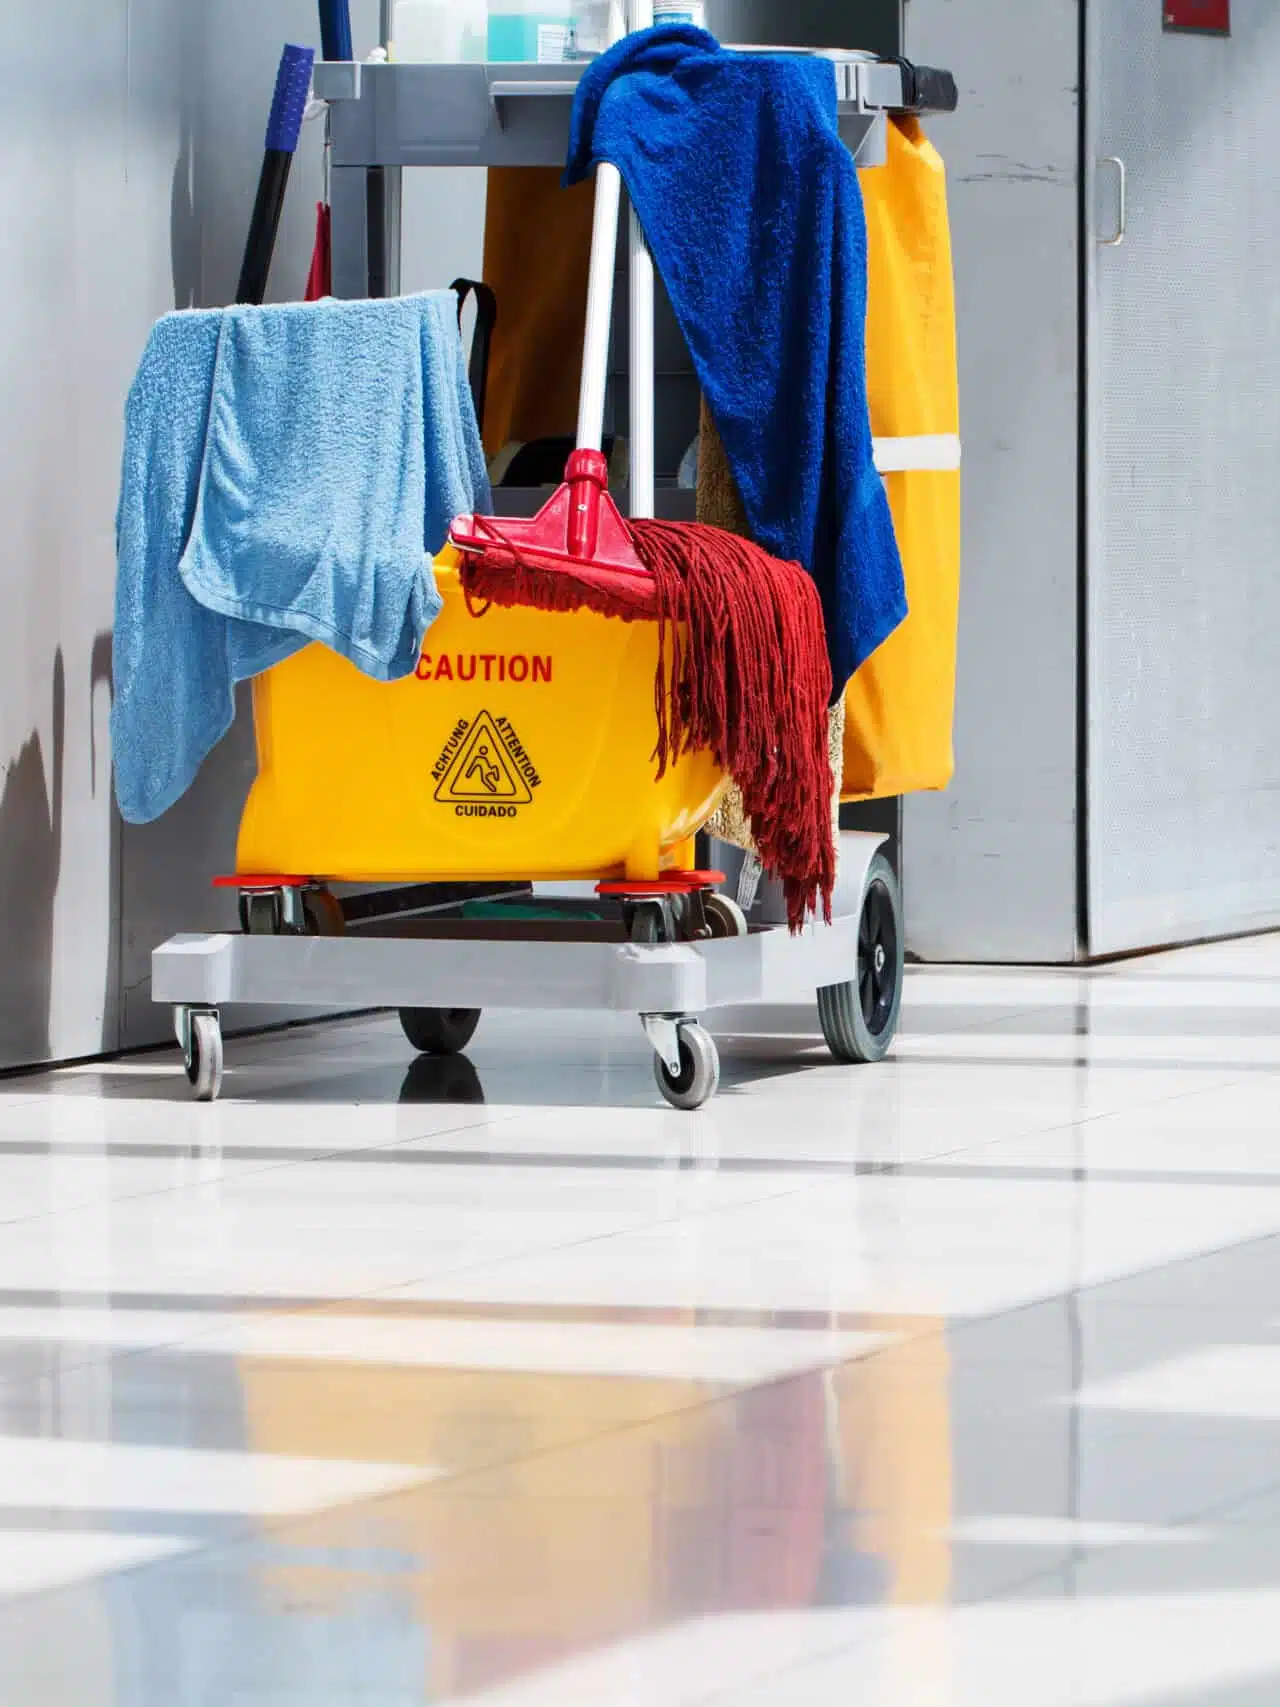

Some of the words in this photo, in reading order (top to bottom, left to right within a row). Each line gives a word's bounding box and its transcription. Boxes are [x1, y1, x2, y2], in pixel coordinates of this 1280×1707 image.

[415, 654, 553, 682] CAUTION
[430, 718, 470, 782] ACHTUNG
[495, 716, 542, 788] ATTENTION
[455, 804, 517, 818] CUIDADO
